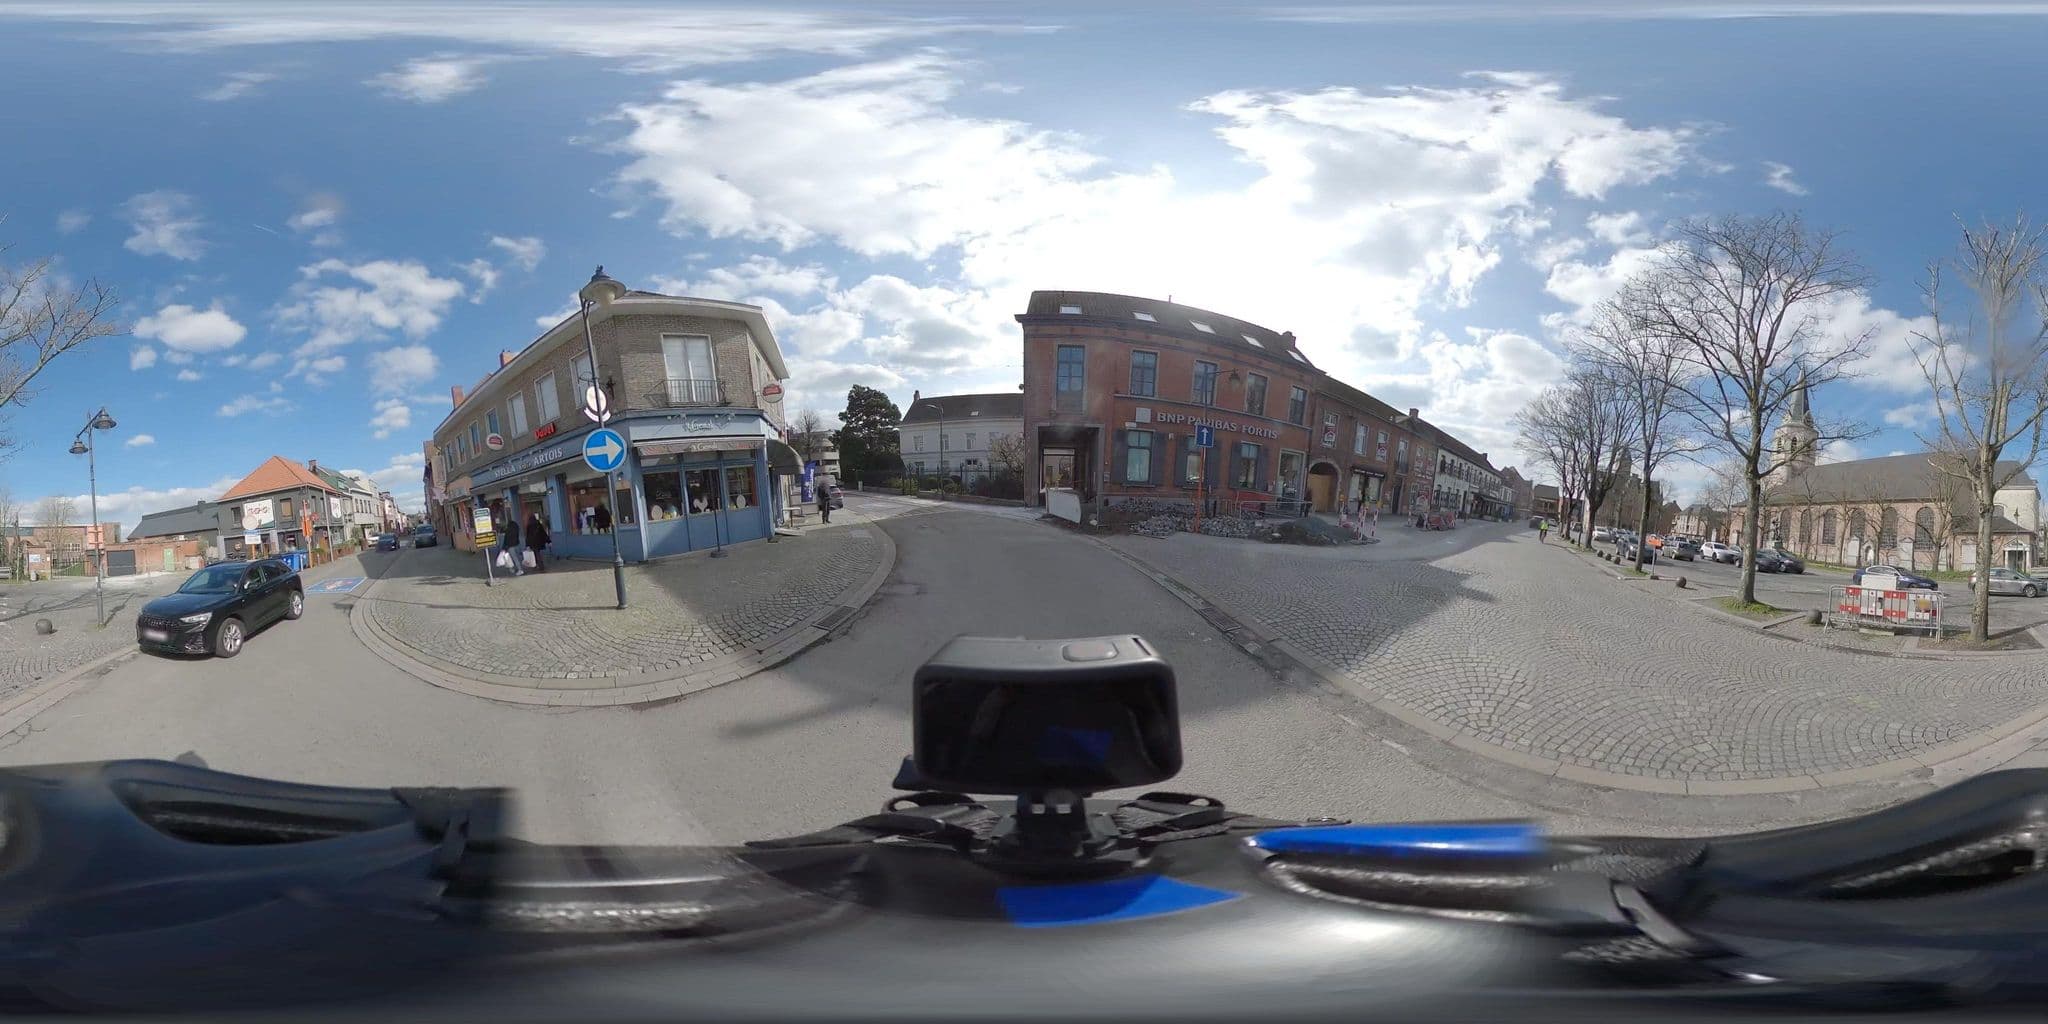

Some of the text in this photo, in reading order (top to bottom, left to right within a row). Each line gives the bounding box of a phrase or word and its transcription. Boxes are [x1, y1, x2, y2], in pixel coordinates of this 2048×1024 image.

[1157, 411, 1279, 440] BNP PARIBAS FORTIS
[534, 448, 563, 466] ARTOIS
